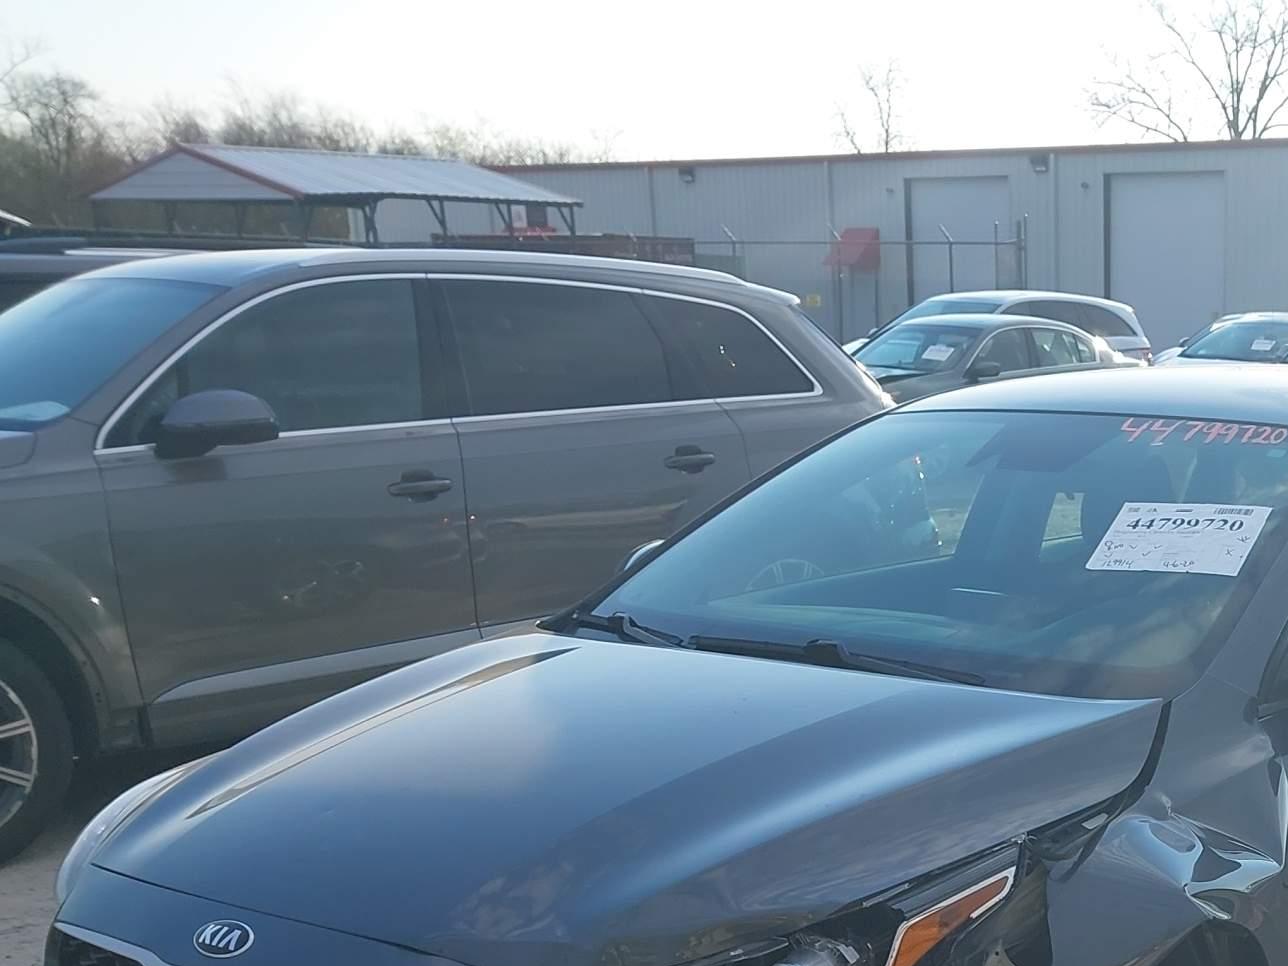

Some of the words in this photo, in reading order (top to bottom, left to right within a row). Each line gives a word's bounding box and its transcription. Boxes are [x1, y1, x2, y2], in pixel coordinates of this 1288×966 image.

[1121, 417, 1288, 444] 44799720
[1126, 517, 1244, 532] 44799720
[199, 924, 242, 951] KIA
